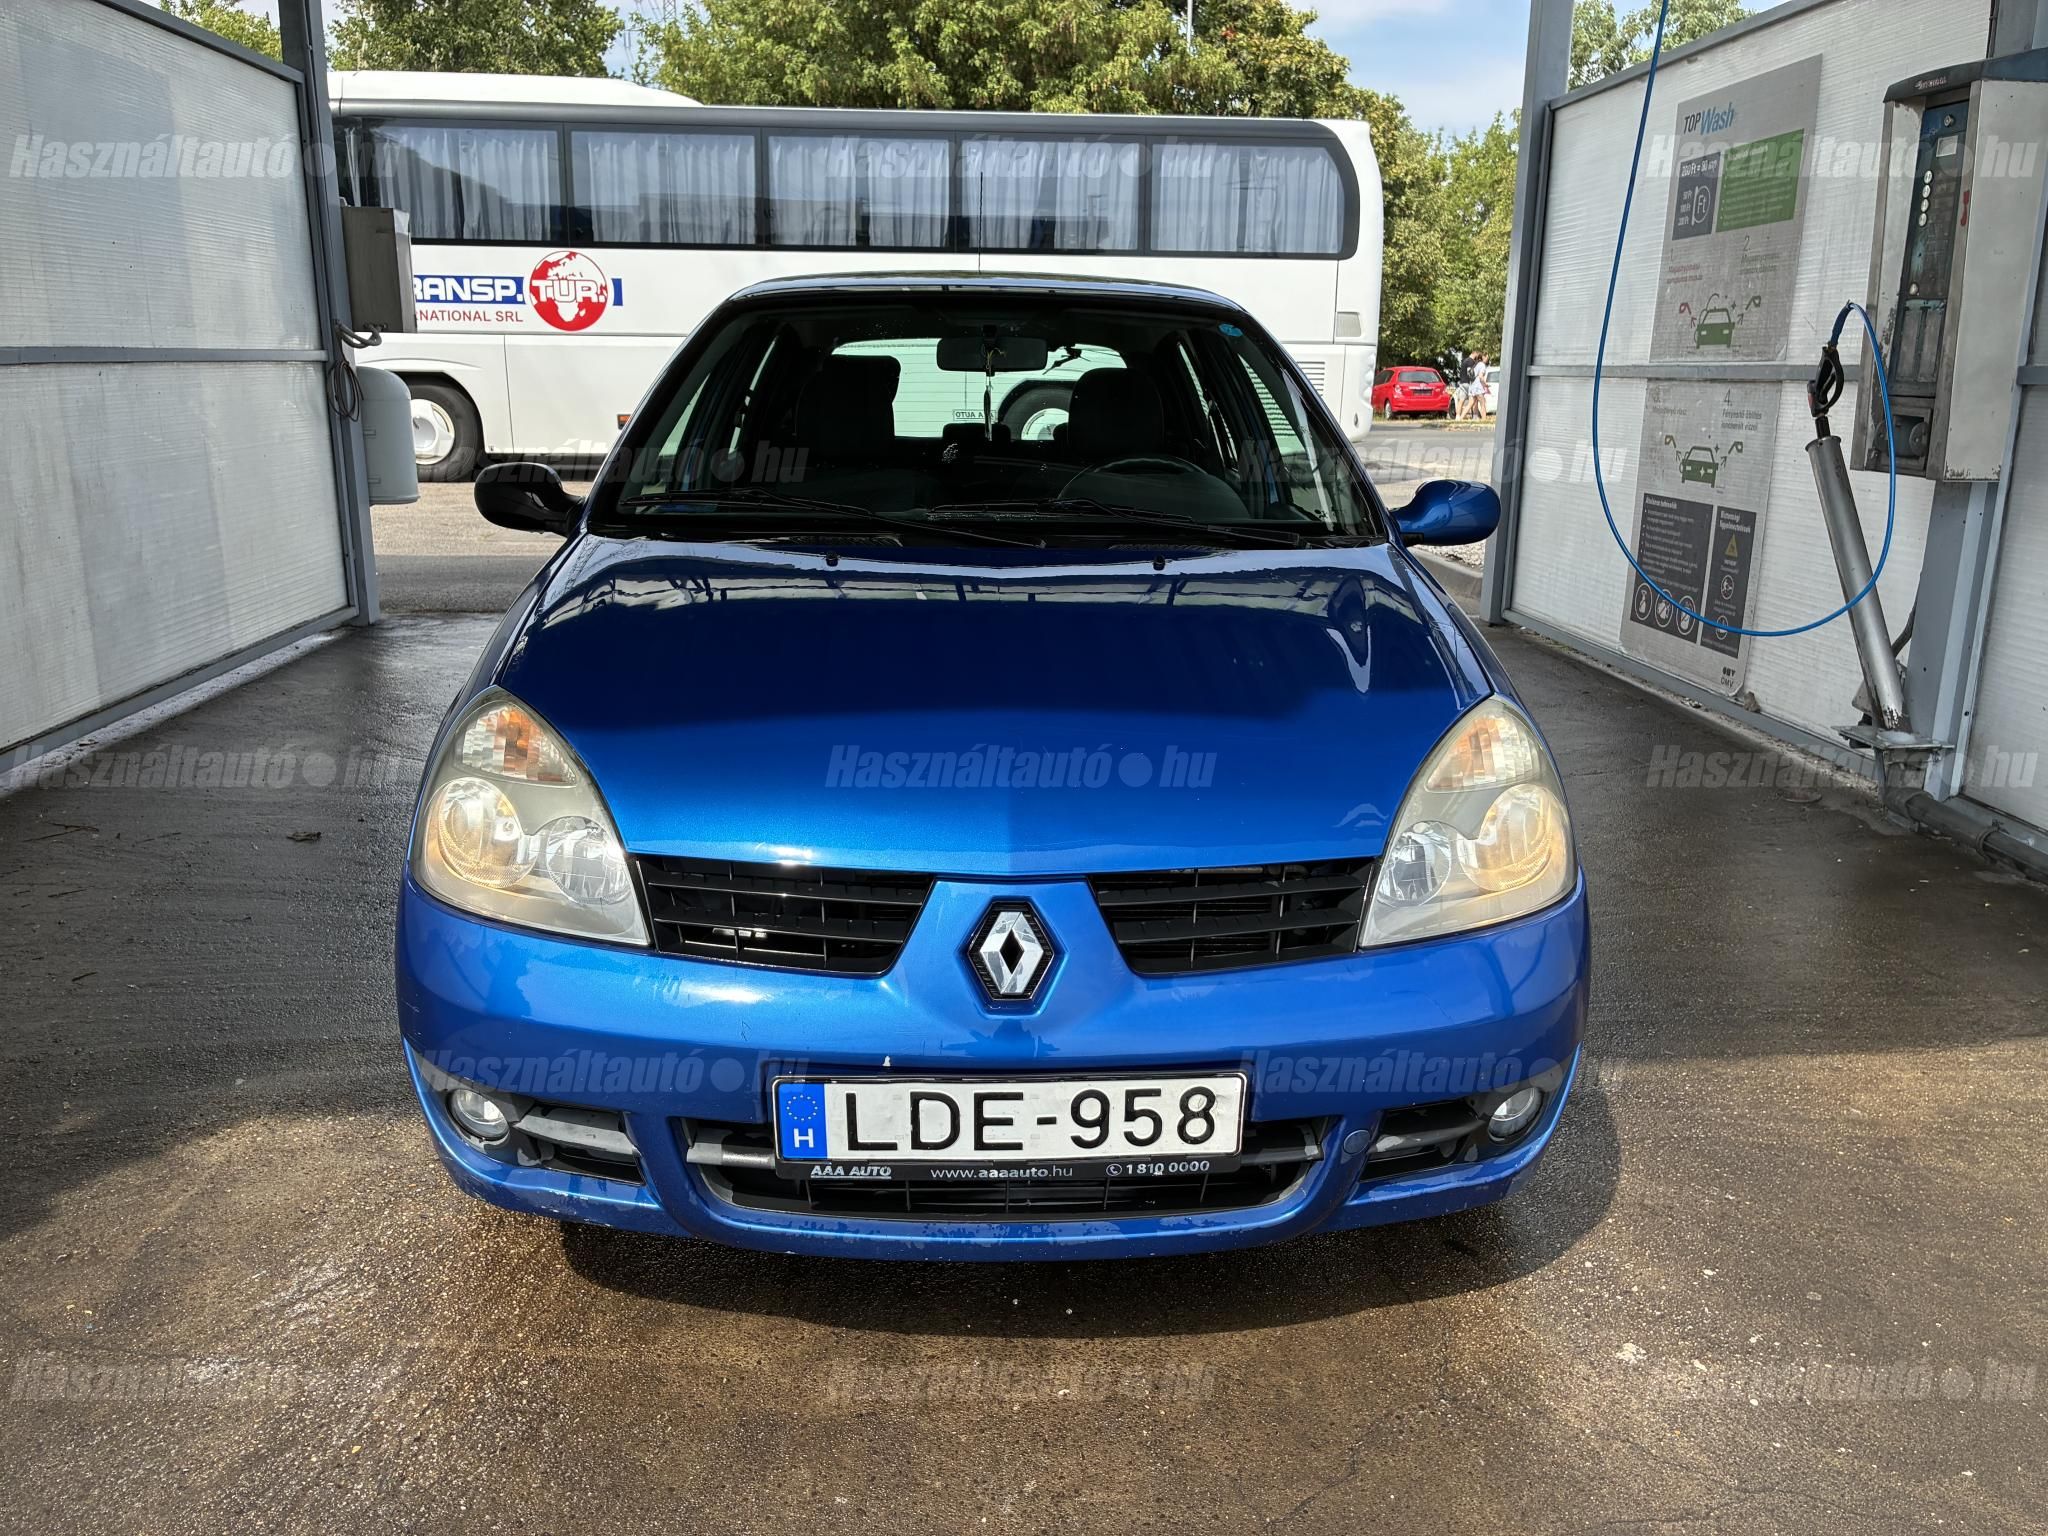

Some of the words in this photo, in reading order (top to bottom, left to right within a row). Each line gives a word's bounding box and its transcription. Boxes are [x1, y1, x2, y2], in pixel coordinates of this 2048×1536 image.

[416, 310, 491, 322] NATIONAL
[496, 311, 523, 322] SRL
[845, 1087, 1215, 1151] LDE-958
[793, 1128, 814, 1148] H
[811, 1165, 845, 1176] AAA
[849, 1166, 892, 1176] AUTO
[930, 1165, 1073, 1178] www.aaaauto.hu
